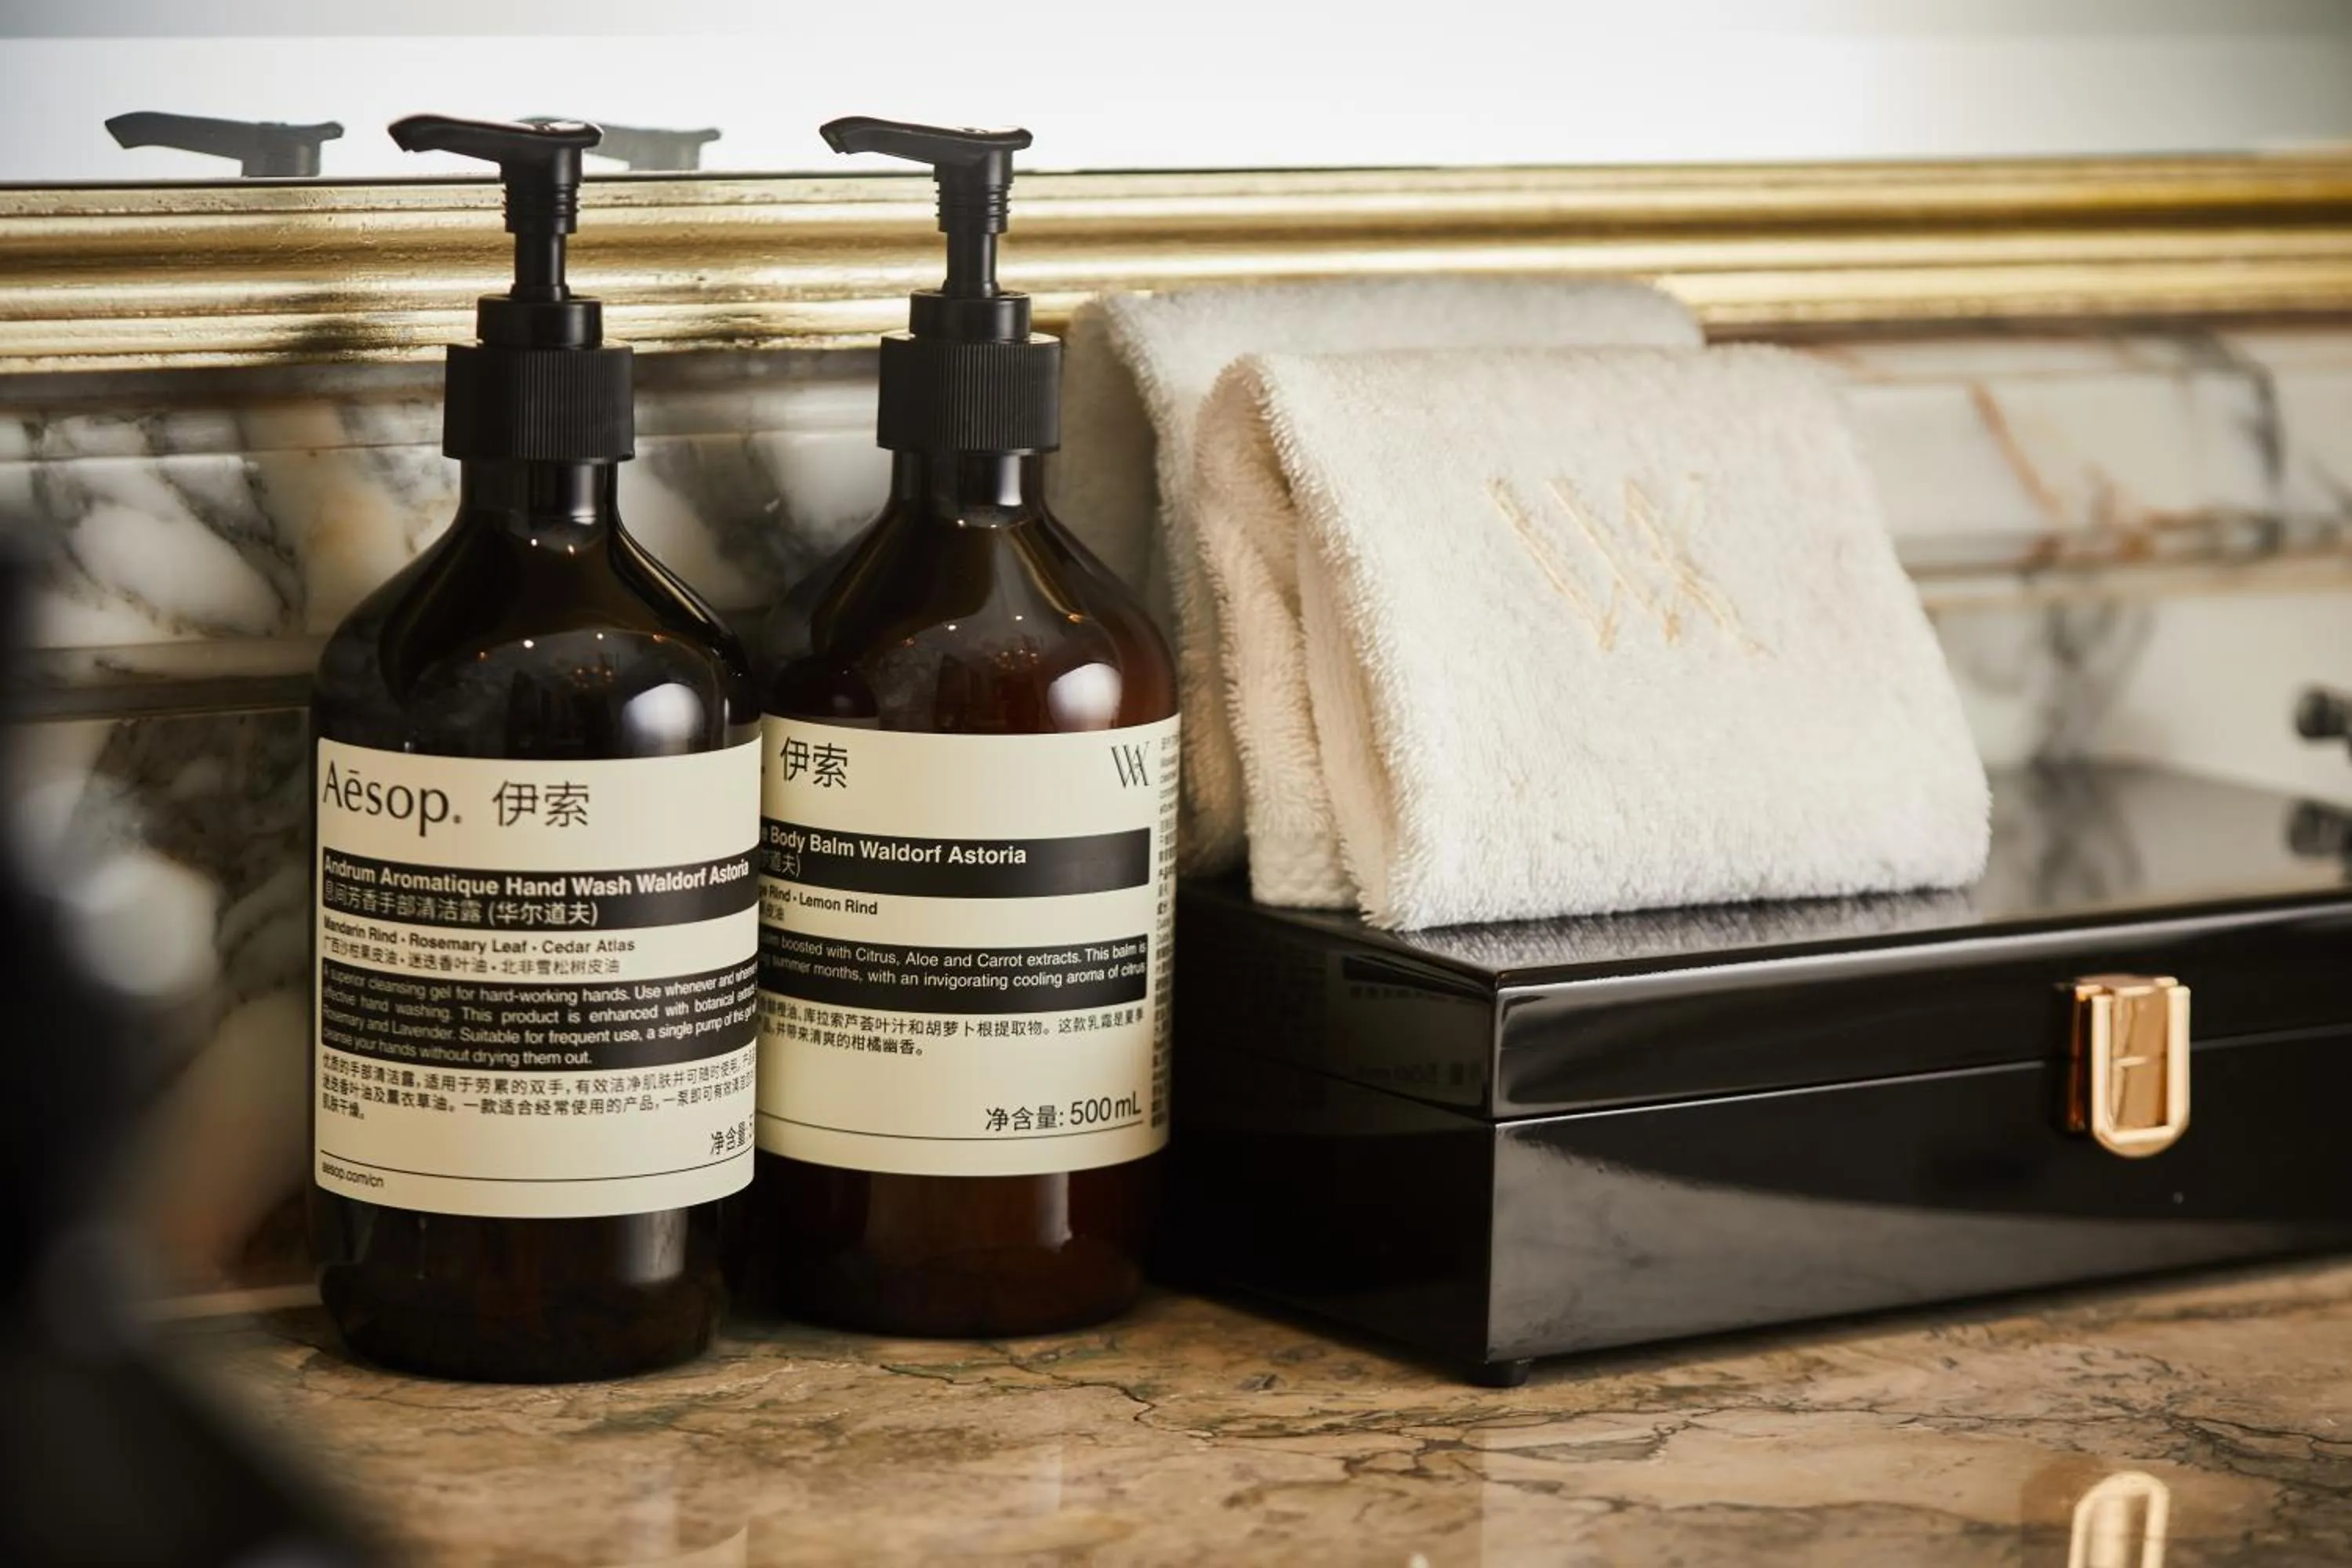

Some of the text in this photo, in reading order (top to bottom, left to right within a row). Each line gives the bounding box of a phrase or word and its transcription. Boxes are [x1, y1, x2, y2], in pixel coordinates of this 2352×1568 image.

[780, 736, 848, 788] 伊索
[492, 779, 590, 828] 伊索
[771, 826, 805, 854] Body
[810, 833, 854, 857] Balm
[859, 840, 942, 863] Waldorf
[948, 844, 1026, 865] Astoria
[325, 855, 749, 896] Andrum Aromatique Hand Wash Waldorf Astoria
[769, 884, 790, 902] Rind
[799, 892, 841, 911] Lemon
[845, 901, 877, 915] Rind
[324, 915, 636, 955] Mandarin Rind Rosemary Leaf Cedar Atlas
[781, 935, 822, 955] boosted
[826, 946, 851, 960] with
[855, 948, 900, 966] Citrus,
[905, 952, 938, 966] Aloe
[944, 953, 971, 967] and
[977, 953, 1022, 967] Carrot
[1026, 951, 1081, 966] extracts.
[1085, 948, 1109, 962] This
[1112, 942, 1137, 958] balm
[1139, 941, 1146, 953] is
[368, 977, 426, 1000] cleansing
[430, 985, 451, 1001] gel
[456, 985, 476, 1000] for
[480, 988, 578, 1007] hard-working
[583, 988, 630, 1002] hands.
[634, 985, 661, 1000] Use
[664, 978, 717, 996] whenever
[719, 971, 734, 987] and
[814, 963, 862, 981] months,
[868, 971, 895, 984] with
[901, 974, 918, 985] an
[924, 972, 1008, 990] invigorating
[1012, 973, 1062, 988] cooling
[1066, 968, 1105, 984] aroma
[1108, 964, 1119, 979] of
[1121, 962, 1146, 977] citrus
[360, 994, 389, 1011] hand
[394, 1002, 452, 1022] washing.
[463, 1006, 492, 1022] This
[501, 1010, 559, 1025] product
[568, 1010, 581, 1023] is
[589, 1005, 658, 1023] enhanced
[665, 1002, 689, 1017] with
[694, 991, 735, 1013] botanical
[366, 1018, 389, 1033] and
[393, 1021, 456, 1039] Lavender.
[459, 1026, 520, 1044] Suitable
[524, 1029, 544, 1044] for
[549, 1029, 610, 1047] frequent
[614, 1027, 643, 1043] use,
[647, 1027, 655, 1039] a
[658, 1022, 693, 1040] single
[695, 1016, 723, 1036] pump
[353, 1035, 377, 1051] your
[379, 1038, 417, 1058] hands
[419, 1047, 470, 1062] without
[473, 1049, 519, 1069] drying
[523, 1051, 561, 1065] them
[564, 1051, 592, 1065] out.
